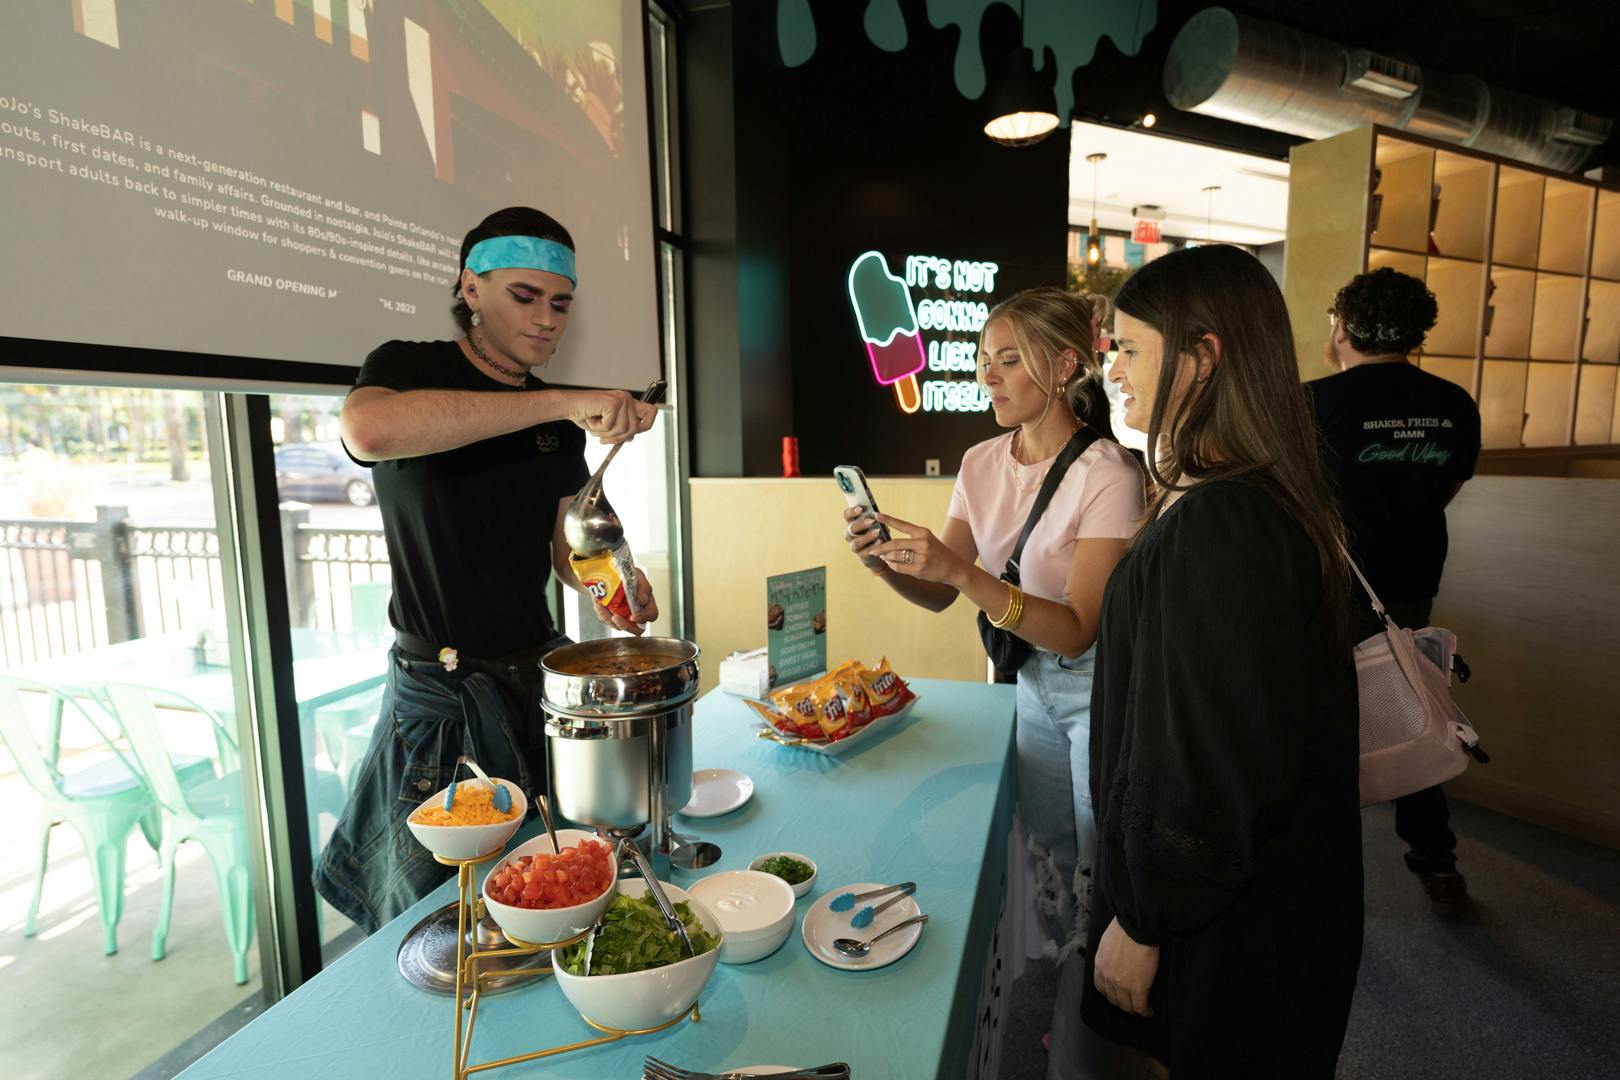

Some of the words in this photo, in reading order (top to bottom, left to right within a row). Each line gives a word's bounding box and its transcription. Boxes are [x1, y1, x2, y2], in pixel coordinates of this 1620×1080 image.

[48, 109, 135, 146] ShakeBAR
[140, 137, 151, 152] is
[156, 145, 163, 155] a
[168, 148, 267, 187] next-generation
[270, 181, 322, 205] restaurant
[325, 198, 343, 212] and
[344, 202, 362, 218] bar,
[364, 210, 381, 222] and
[0, 146, 64, 173] nsport
[68, 163, 120, 187] adults
[124, 176, 159, 197] back
[162, 187, 177, 201] to
[181, 193, 227, 214] simpler
[231, 205, 263, 223] times
[266, 216, 290, 230] with
[292, 220, 306, 235] its
[307, 225, 385, 255] 80s/90s-inspired
[52, 134, 87, 156] first
[92, 146, 139, 171] dates,
[144, 162, 170, 178] and
[173, 169, 213, 192] family
[217, 184, 258, 203] affairs.
[261, 194, 312, 219] Grounded
[314, 210, 324, 222] in
[326, 216, 371, 237] nostalgia,
[154, 207, 209, 229] walk-up
[212, 221, 260, 240] window
[262, 231, 278, 245] for
[281, 236, 328, 257] shoppers
[328, 248, 337, 259] &
[339, 252, 386, 271] convention
[411, 270, 422, 279] on
[227, 269, 273, 288] GRAND
[275, 278, 326, 298] OPENING
[395, 301, 416, 314] 2023
[906, 255, 950, 289] IT'S
[953, 260, 999, 293] NOT
[918, 298, 989, 331] GONNA
[928, 339, 977, 372] LICK
[1363, 419, 1406, 430] SHAKES,
[1407, 418, 1439, 428] FRIES
[1441, 419, 1453, 429] &
[1393, 430, 1425, 439] DAMN
[1359, 441, 1410, 462] Good
[1412, 441, 1450, 465] Vibes
